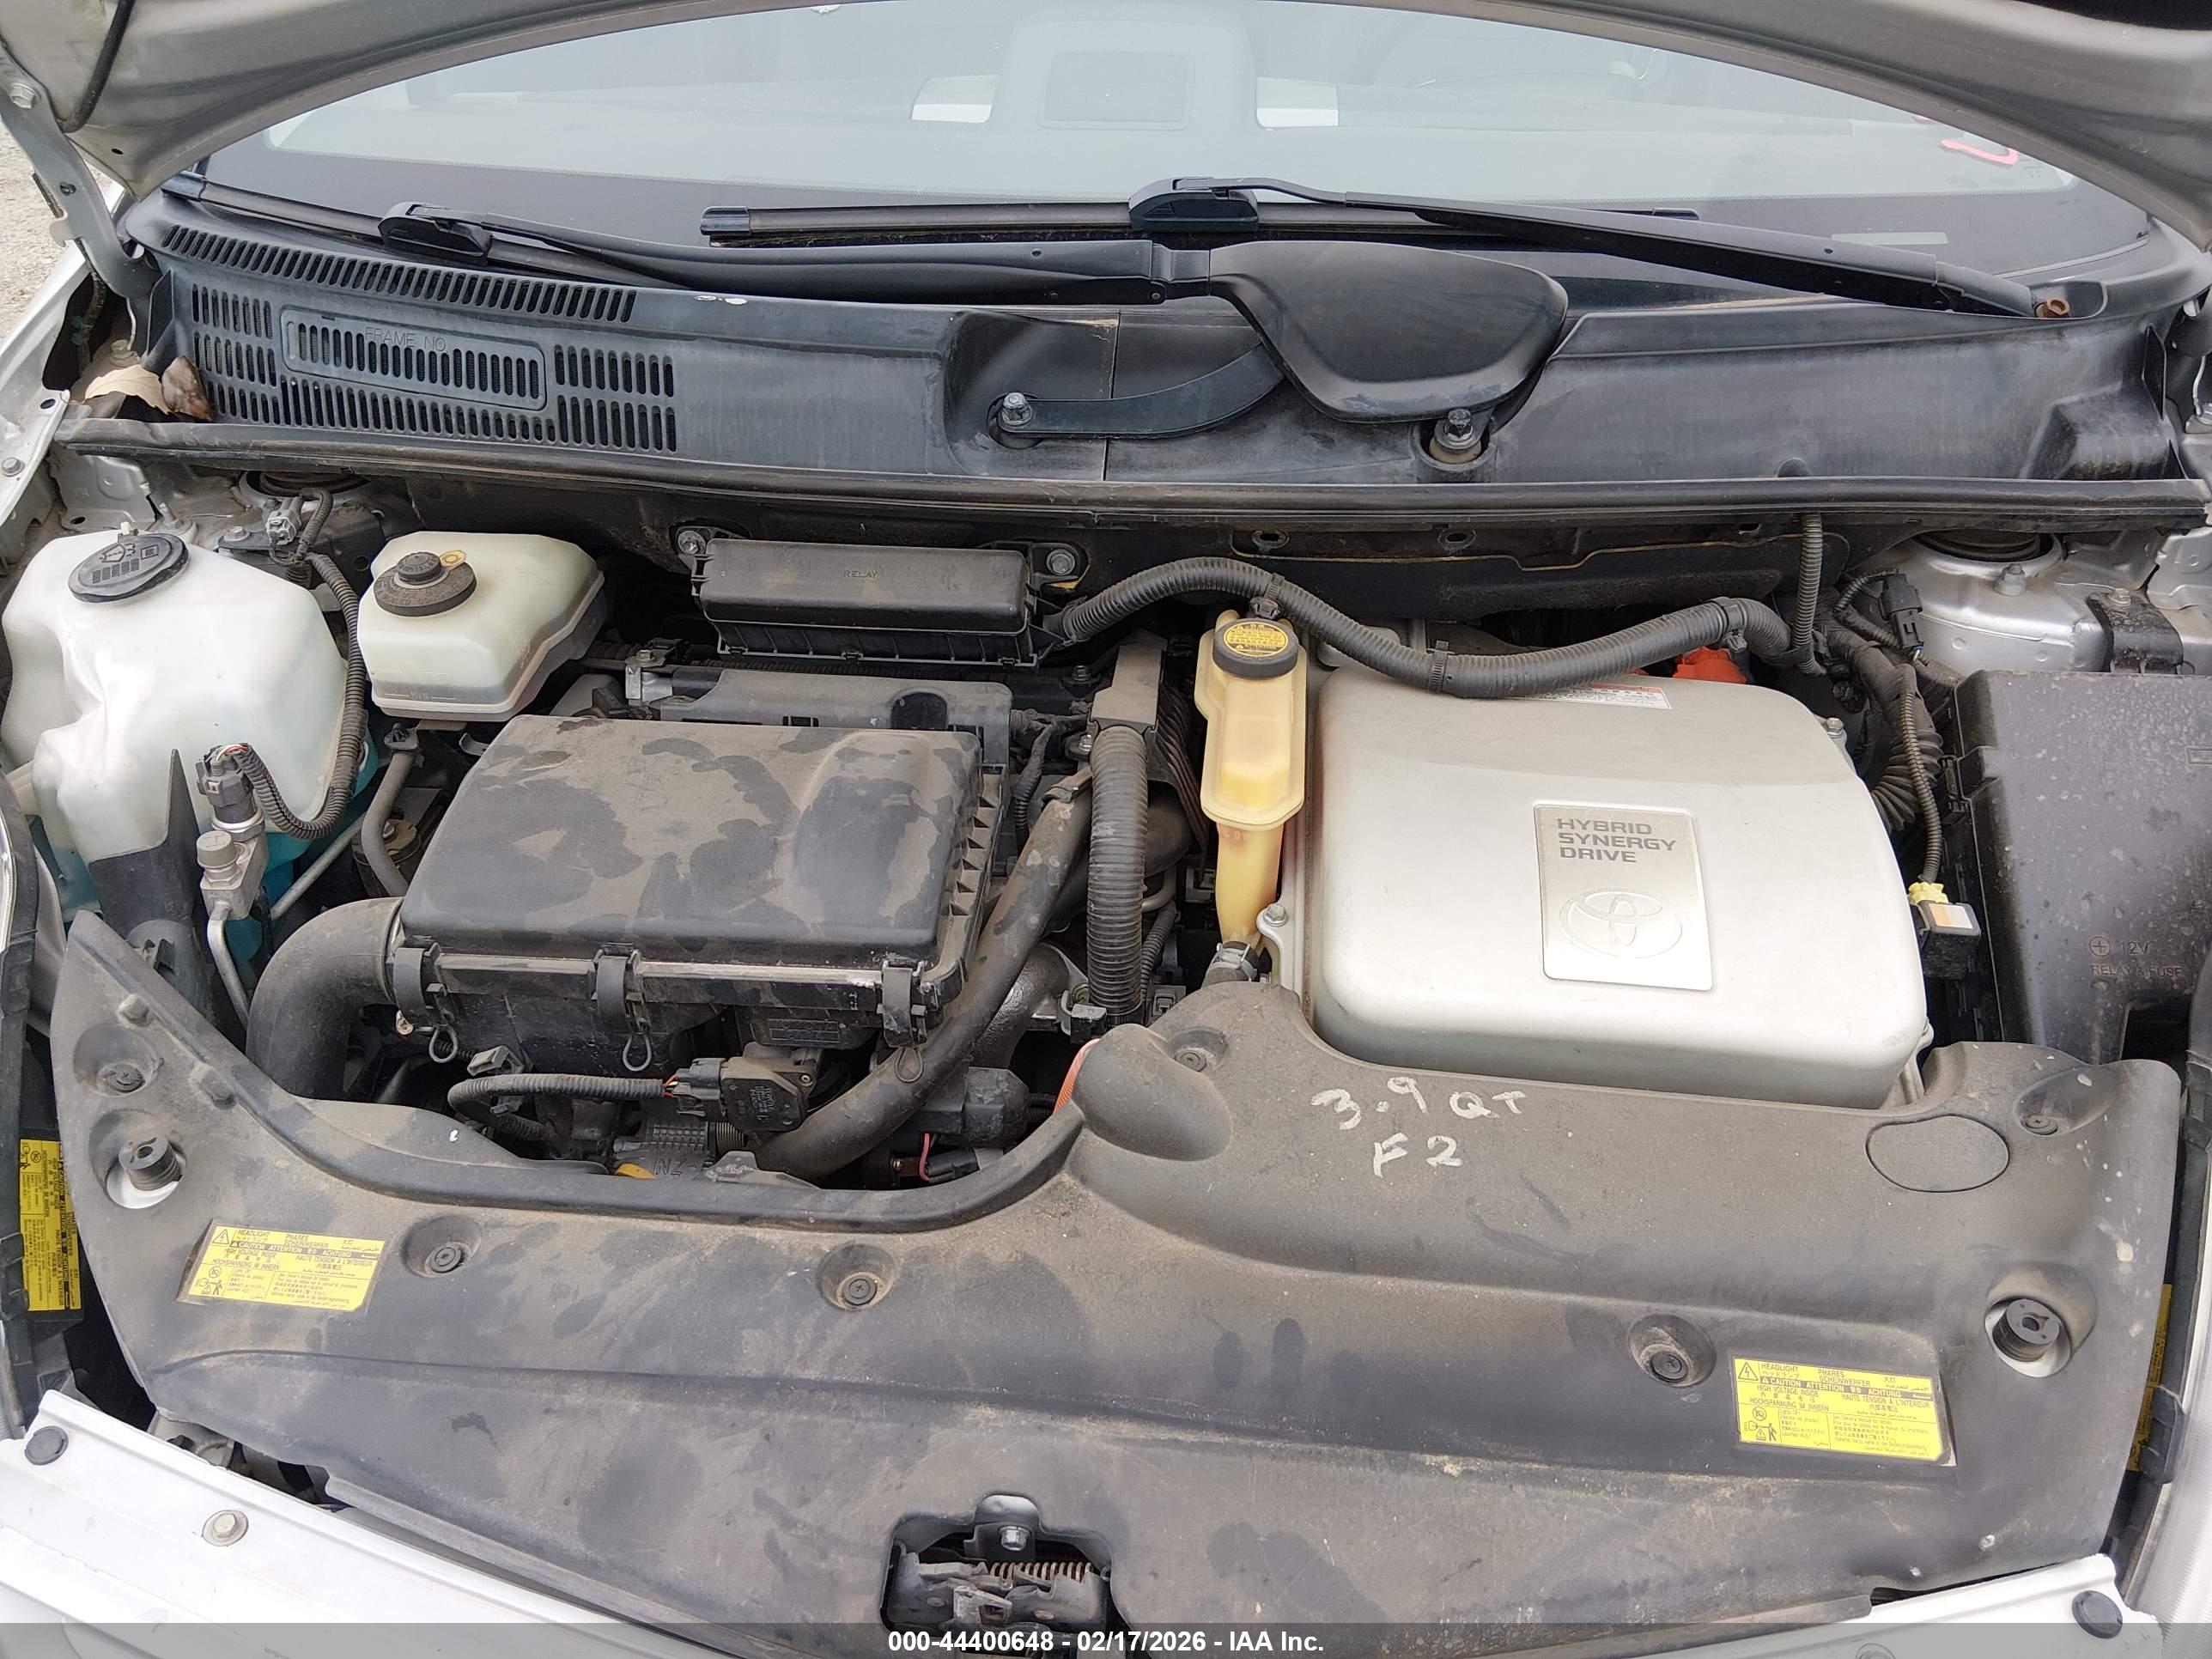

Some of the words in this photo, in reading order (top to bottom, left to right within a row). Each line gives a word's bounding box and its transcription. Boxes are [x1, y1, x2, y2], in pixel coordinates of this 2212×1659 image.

[365, 326, 416, 348] FRAME
[843, 569, 878, 579] RELAY
[1557, 817, 1652, 835] HYBRID
[1558, 832, 1676, 851] SYNERGY
[1559, 847, 1637, 863] DRIVE
[2118, 940, 2150, 955] 12V
[2089, 964, 2130, 976] RELAY
[2136, 966, 2145, 976] &
[2149, 966, 2182, 977] FUSE
[1310, 1076, 1428, 1130] 3.9
[1449, 1091, 1527, 1120] QT
[238, 1229, 270, 1237] HEADLIGHT
[239, 1242, 264, 1251] CAUTION
[270, 1244, 303, 1255] ATTENTION
[321, 1249, 352, 1258] ACHTUNG
[1761, 1363, 1799, 1372] HEADLIGHT
[1818, 1369, 1844, 1378] PHARES
[1770, 1378, 1802, 1388] CAUTION
[1806, 1382, 1844, 1392] ATTENTION
[1868, 1389, 1901, 1398] ACHTUNG
[1819, 1376, 1870, 1388] SCHEINWERFER
[1773, 1386, 1798, 1395] VOLTAGE
[1801, 1389, 1819, 1397] INSIDE
[1841, 1393, 1861, 1402] HAUTE
[1863, 1395, 1887, 1405] TENSION
[1749, 1396, 1797, 1409] HOCHSPANNUNG
[1808, 1403, 1829, 1413] INNERN
